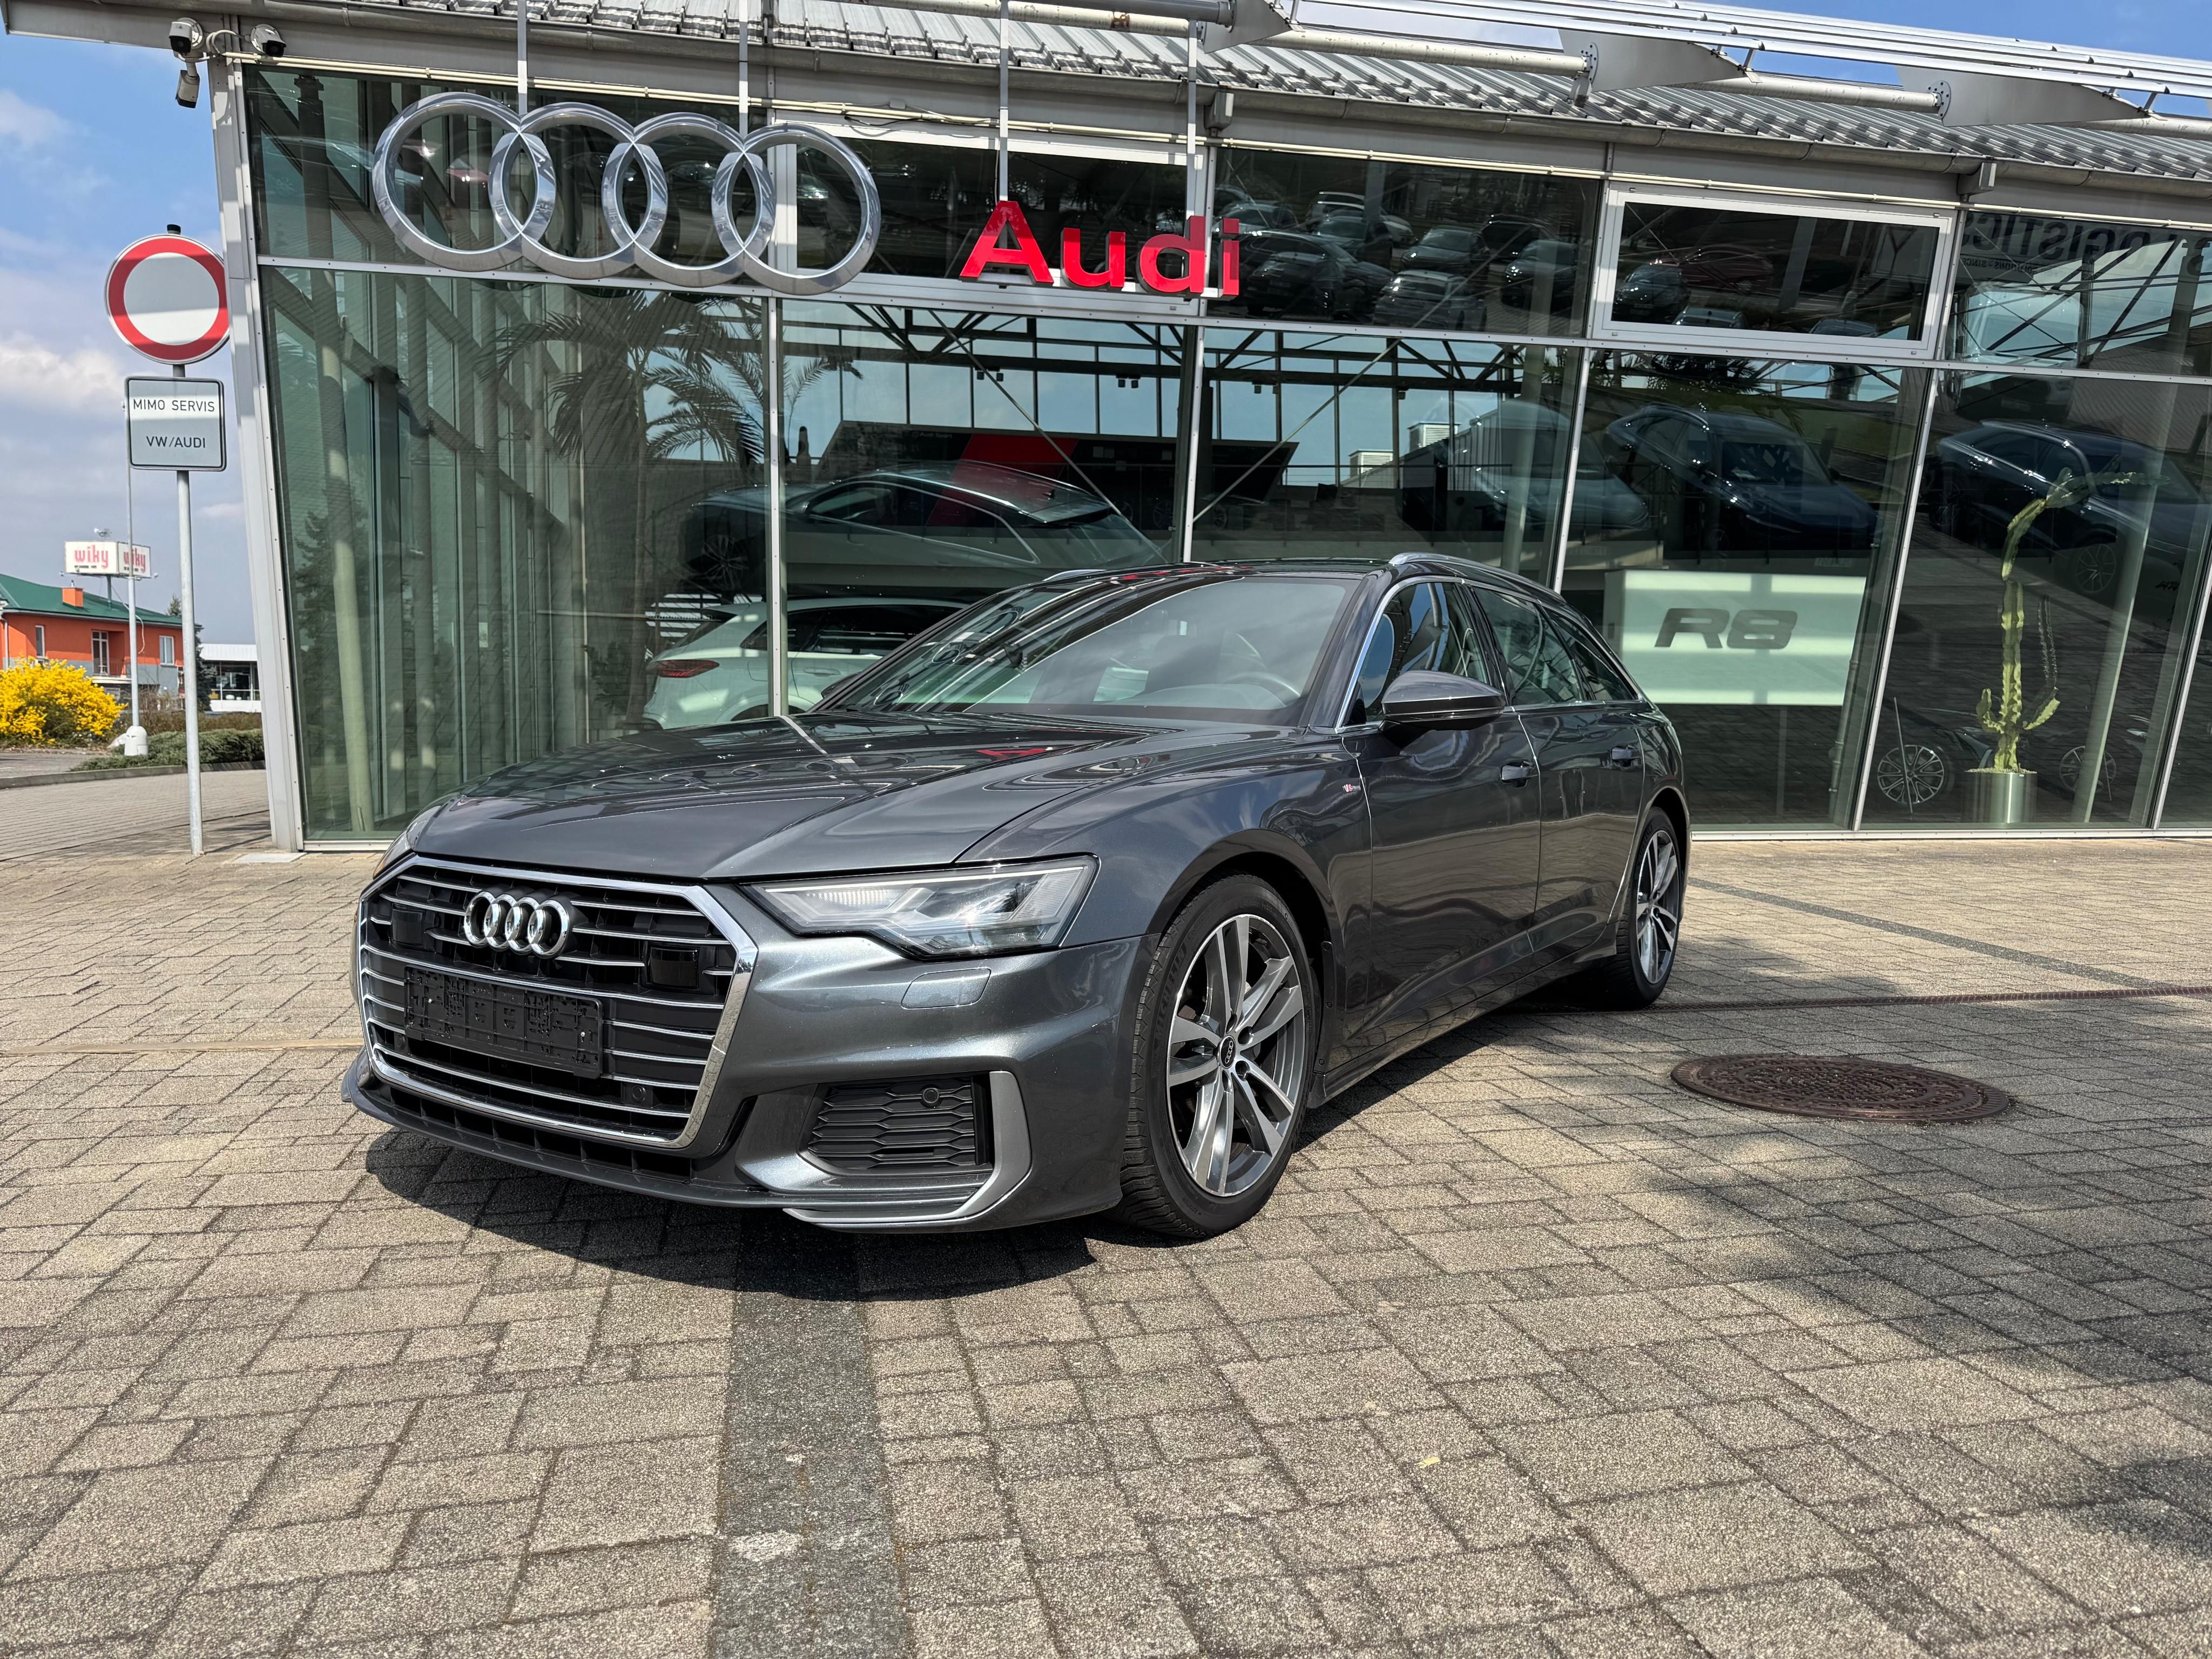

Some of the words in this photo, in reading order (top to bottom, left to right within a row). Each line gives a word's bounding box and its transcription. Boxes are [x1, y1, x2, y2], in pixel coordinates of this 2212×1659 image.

[959, 200, 1239, 298] Audi
[133, 399, 165, 410] MIMO
[172, 400, 215, 412] SERVIS
[146, 436, 205, 448] VW/AUDI
[75, 544, 109, 570] wiky
[1654, 608, 1798, 649] R8
